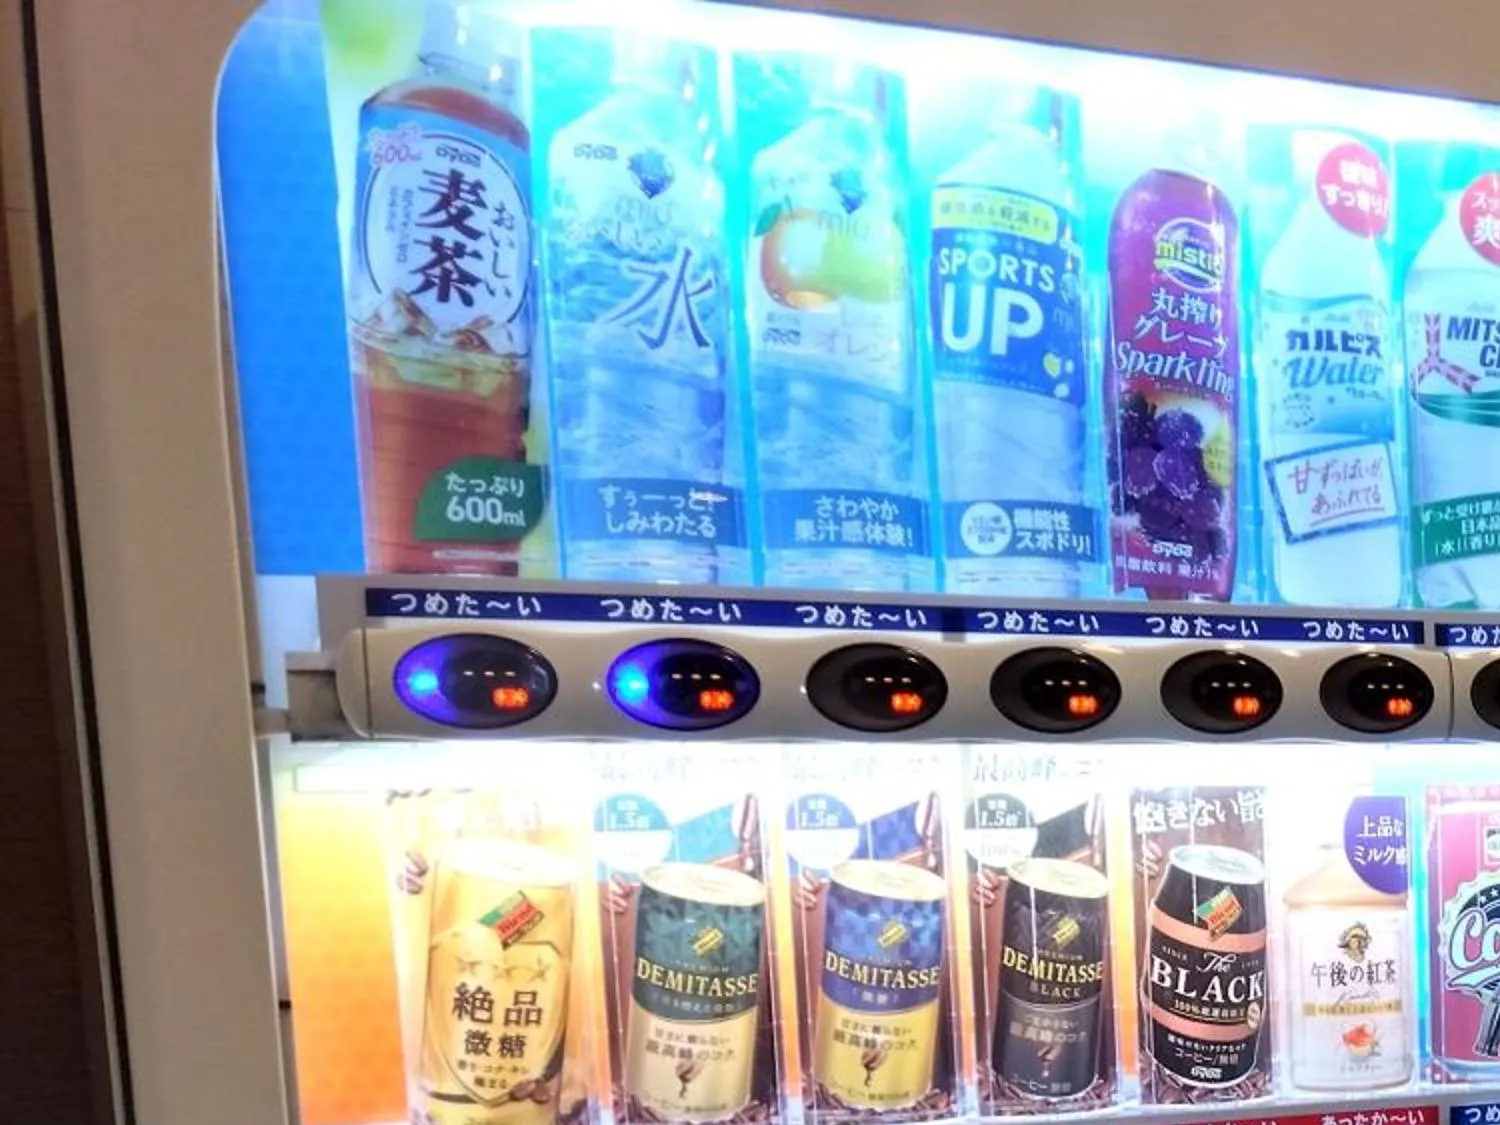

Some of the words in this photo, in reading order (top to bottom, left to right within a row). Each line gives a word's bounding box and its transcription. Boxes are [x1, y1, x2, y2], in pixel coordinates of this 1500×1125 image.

[409, 168, 488, 308] 麦茶
[482, 200, 515, 298] おいしい
[938, 247, 1055, 293] SPORTS
[602, 246, 714, 351] 水
[1150, 287, 1223, 331] 丸搾り
[941, 281, 1045, 357] UP
[1285, 329, 1382, 358] カルピス
[1283, 355, 1384, 389] Water
[446, 472, 525, 499] たっぷり
[446, 497, 526, 528] 600ml
[814, 495, 899, 519] さわやか
[606, 511, 717, 538] しみわたる
[1015, 530, 1092, 557] スポドリ!
[1356, 815, 1403, 837] 上品な
[637, 956, 759, 998] DEMITASSE
[824, 949, 939, 991] DEMITASSE
[1002, 946, 1103, 985] DEMITASSE
[1151, 954, 1264, 1004] BLACK
[1195, 951, 1237, 973] The
[1311, 959, 1397, 989] 午後の紅茶
[452, 981, 544, 1027] 絶品
[1030, 981, 1082, 1000] BLACK
[464, 1029, 528, 1059] 微糖
